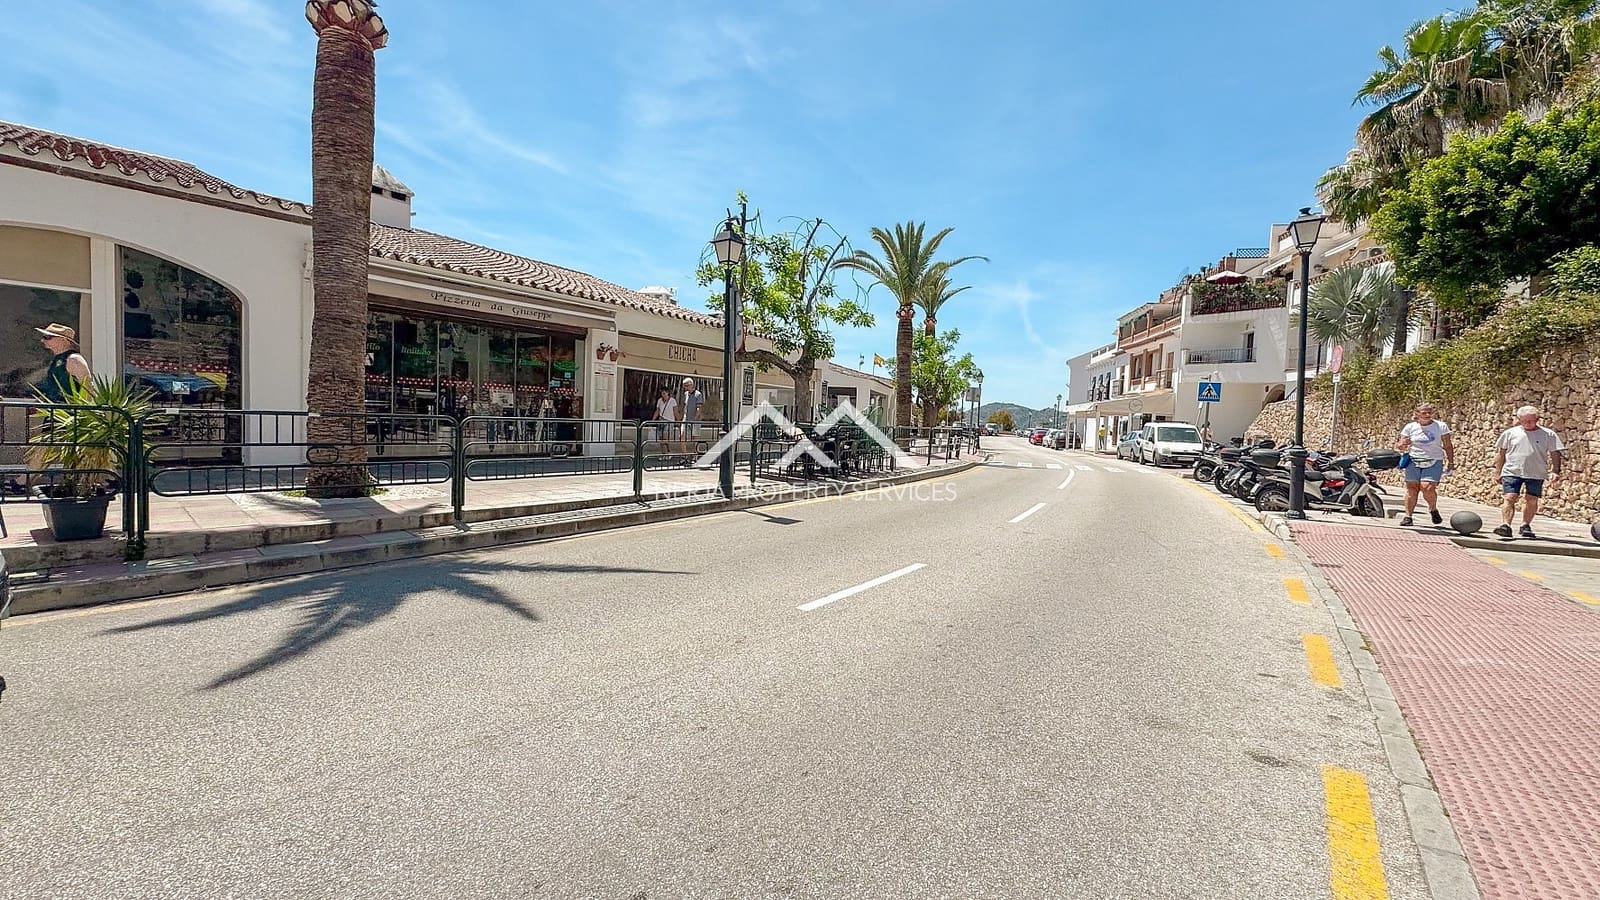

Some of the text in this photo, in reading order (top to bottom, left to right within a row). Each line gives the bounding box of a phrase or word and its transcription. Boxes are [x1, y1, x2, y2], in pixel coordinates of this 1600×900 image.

[430, 291, 553, 321] Pizzeria da Giuseppe
[668, 344, 697, 363] CHICHA
